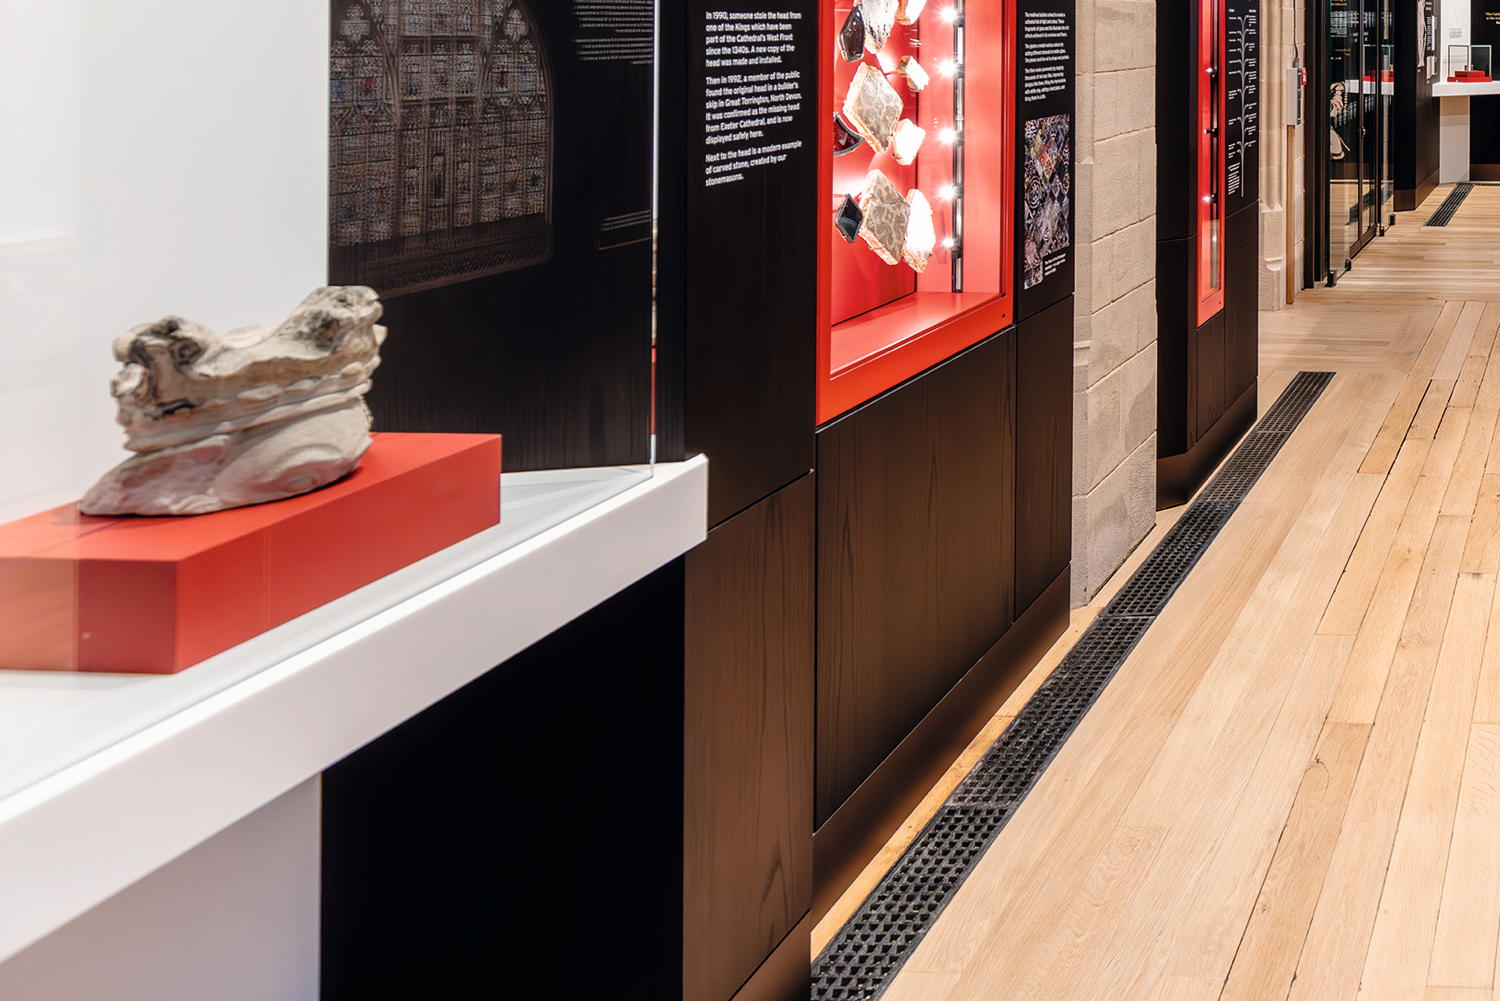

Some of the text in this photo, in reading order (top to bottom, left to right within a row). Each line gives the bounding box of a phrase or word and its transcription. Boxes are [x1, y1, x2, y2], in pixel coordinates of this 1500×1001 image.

[735, 23, 750, 32] Kings
[706, 36, 718, 45] part
[706, 47, 720, 55] since
[706, 59, 720, 67] head
[706, 77, 720, 85] Then
[770, 72, 775, 80] of
[786, 71, 799, 79] public
[734, 86, 753, 95] original
[706, 101, 717, 109] skip
[724, 108, 750, 118] confirmed
[706, 124, 719, 132] from
[721, 122, 738, 130] Exeter
[706, 135, 732, 144] displayed
[733, 132, 749, 140] safely
[706, 154, 719, 162] Next
[762, 145, 780, 153] modern
[782, 140, 802, 149] example
[706, 166, 712, 174] of
[713, 163, 732, 172] carved
[750, 157, 769, 166] created
